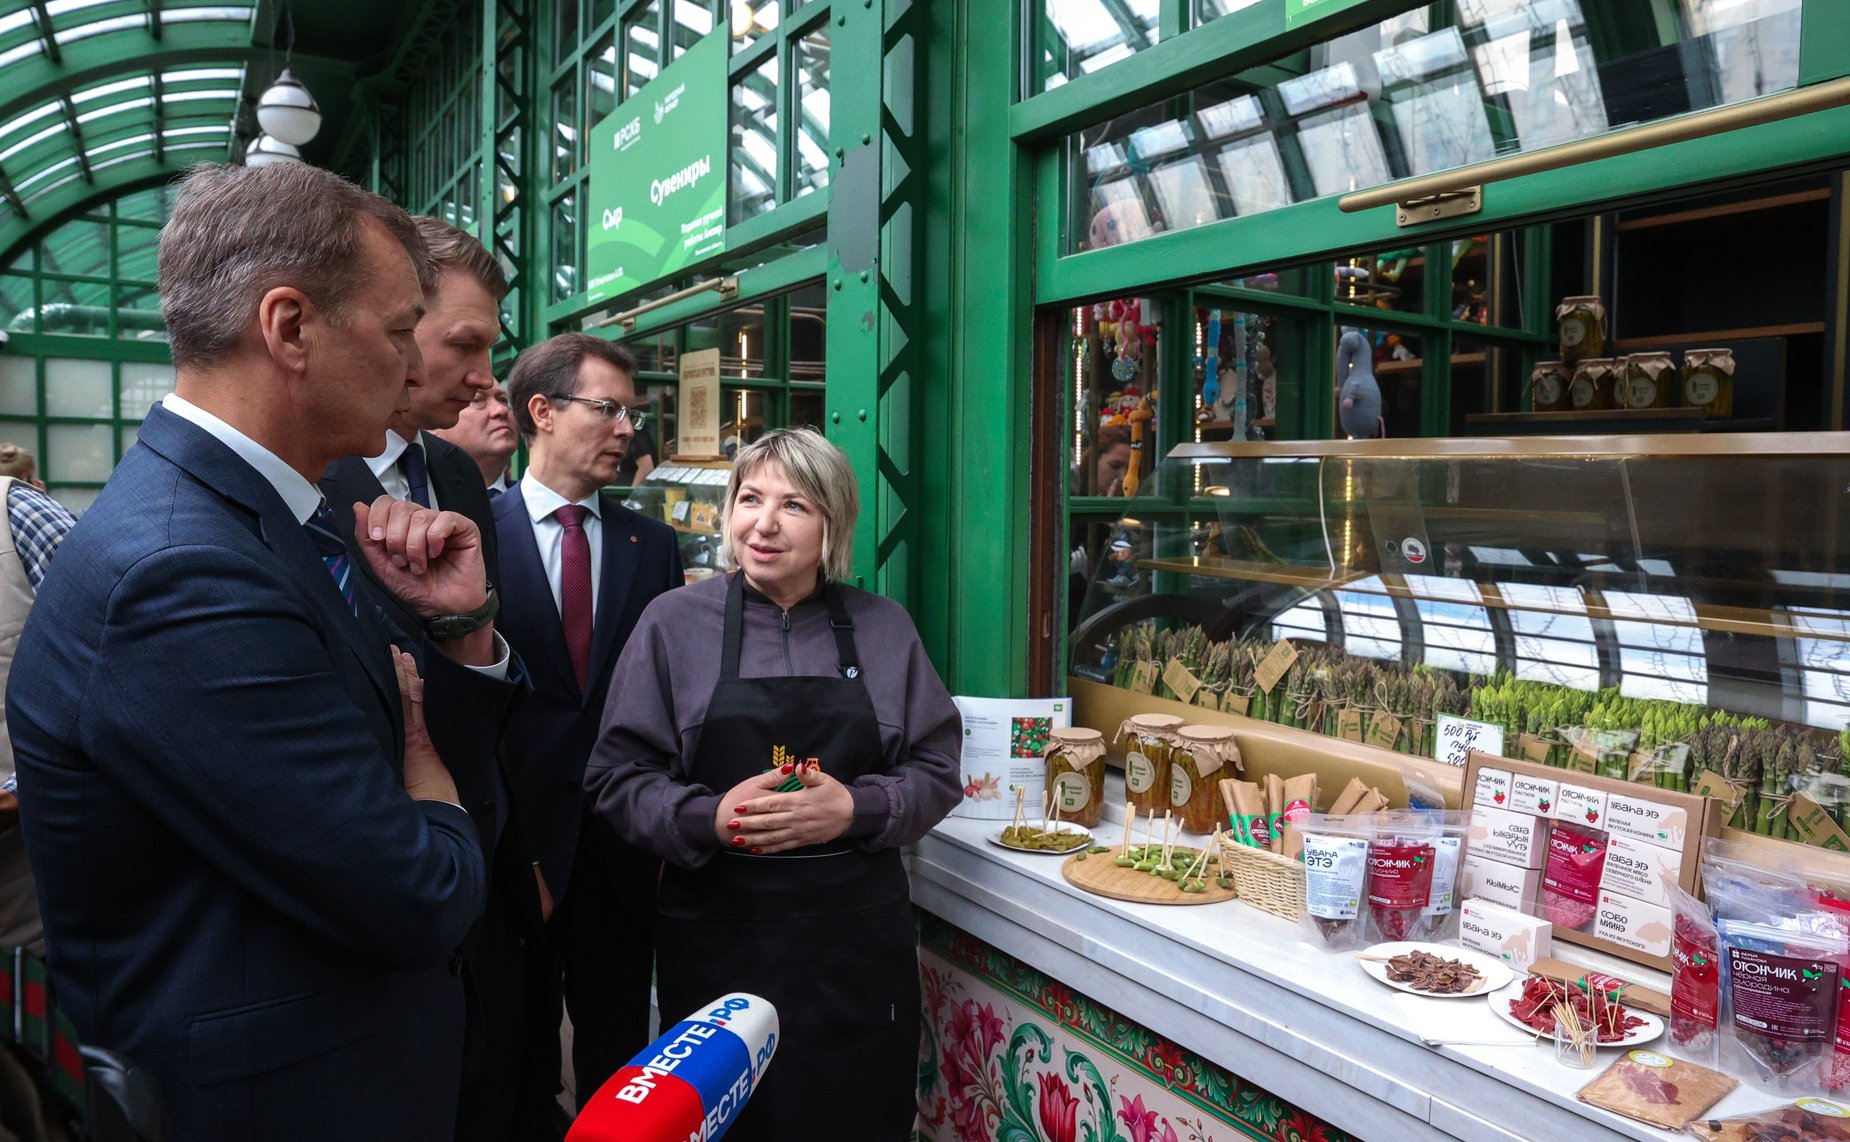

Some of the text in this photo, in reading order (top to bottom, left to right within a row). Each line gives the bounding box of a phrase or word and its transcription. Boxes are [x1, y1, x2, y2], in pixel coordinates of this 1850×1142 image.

[650, 154, 710, 206] Сувениры
[603, 206, 622, 230] Сыр
[1444, 725, 1463, 737] 500
[1608, 817, 1631, 827] ВЯЛЕНАЯ
[1607, 823, 1655, 839] ЯКУТСКАЯ КОНИНА
[1306, 856, 1333, 868] ЭТЭ
[1633, 869, 1649, 878] МЯСО
[1616, 936, 1646, 949] ЯКУТСКОГО
[1733, 960, 1798, 981] ОТОНЧИК
[1733, 977, 1790, 994] смородина
